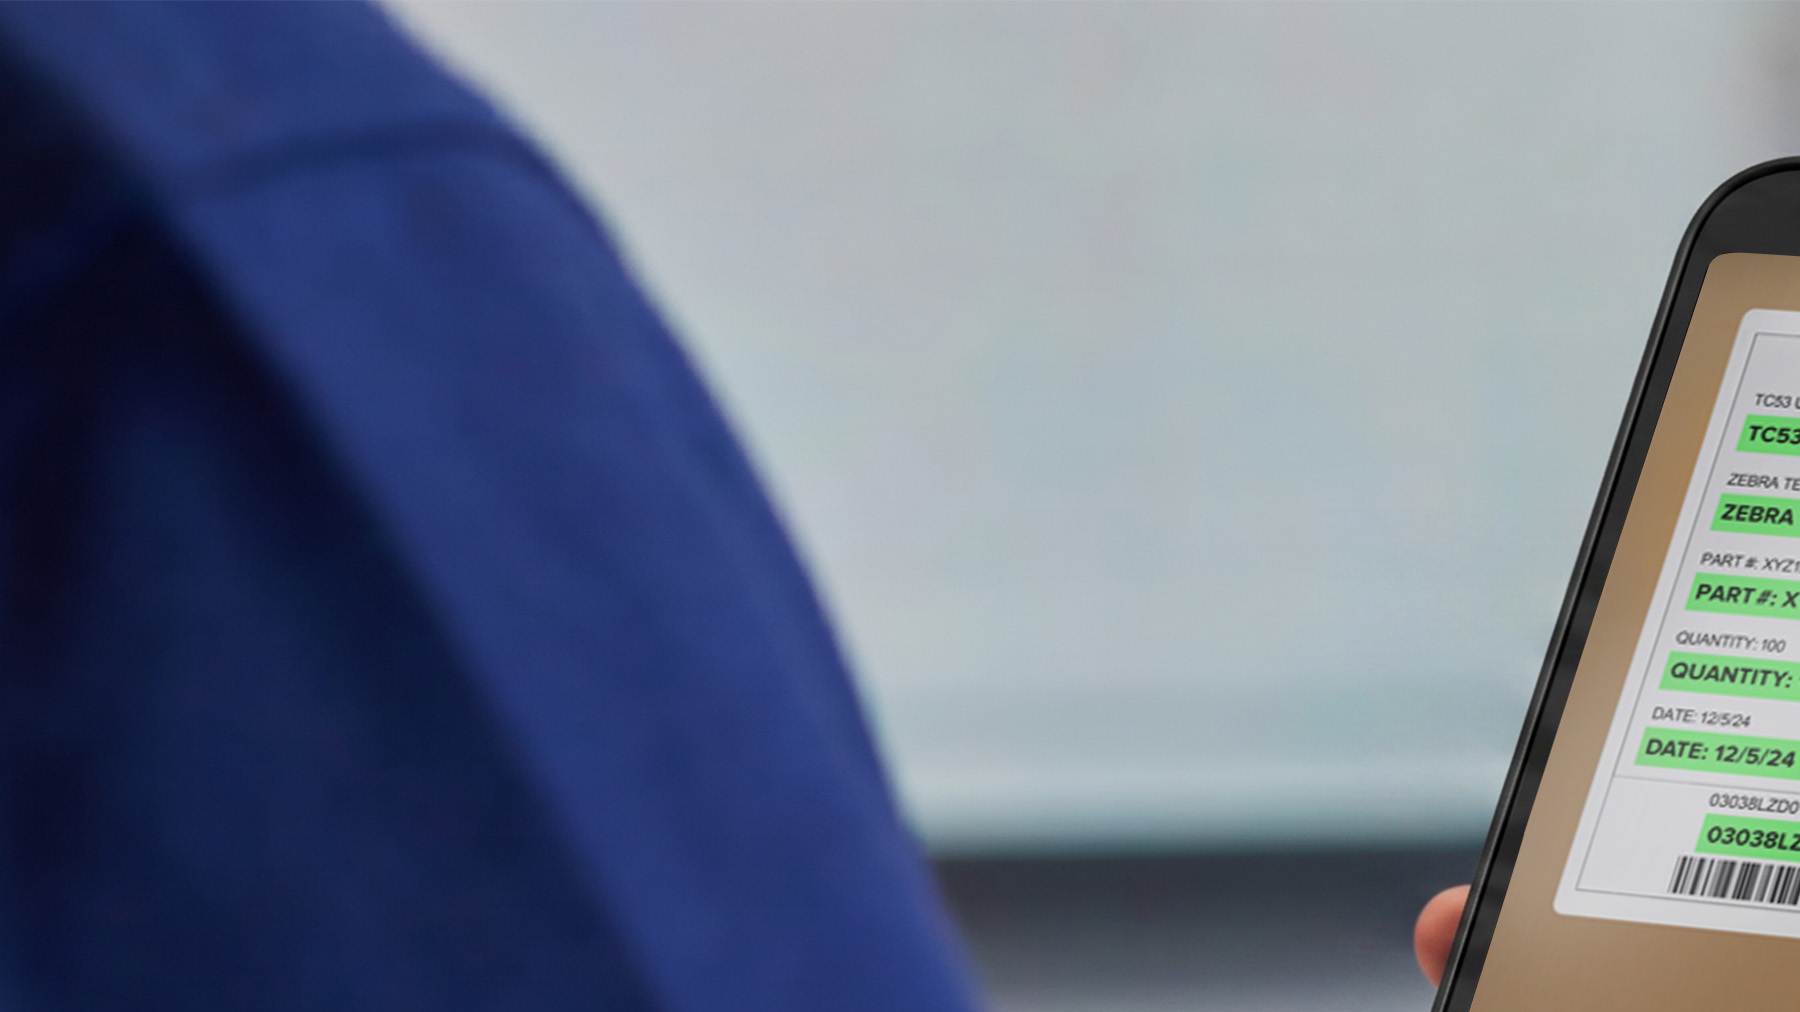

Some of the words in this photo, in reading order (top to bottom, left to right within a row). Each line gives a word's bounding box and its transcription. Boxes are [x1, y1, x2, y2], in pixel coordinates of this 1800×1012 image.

[1755, 393, 1792, 408] TC53
[1726, 473, 1780, 489] ZEBRA
[1720, 503, 1794, 525] ZEBRA
[1700, 552, 1745, 568] PART
[1695, 584, 1757, 605] PART
[1675, 630, 1759, 651] QUANTITY:
[1760, 639, 1787, 653] 100
[1670, 662, 1793, 689] QUANTITY:
[1651, 706, 1698, 724] DATE:
[1700, 711, 1752, 728] 12/5/24
[1645, 738, 1710, 760] DATE:
[1714, 745, 1796, 768] 12/5/24
